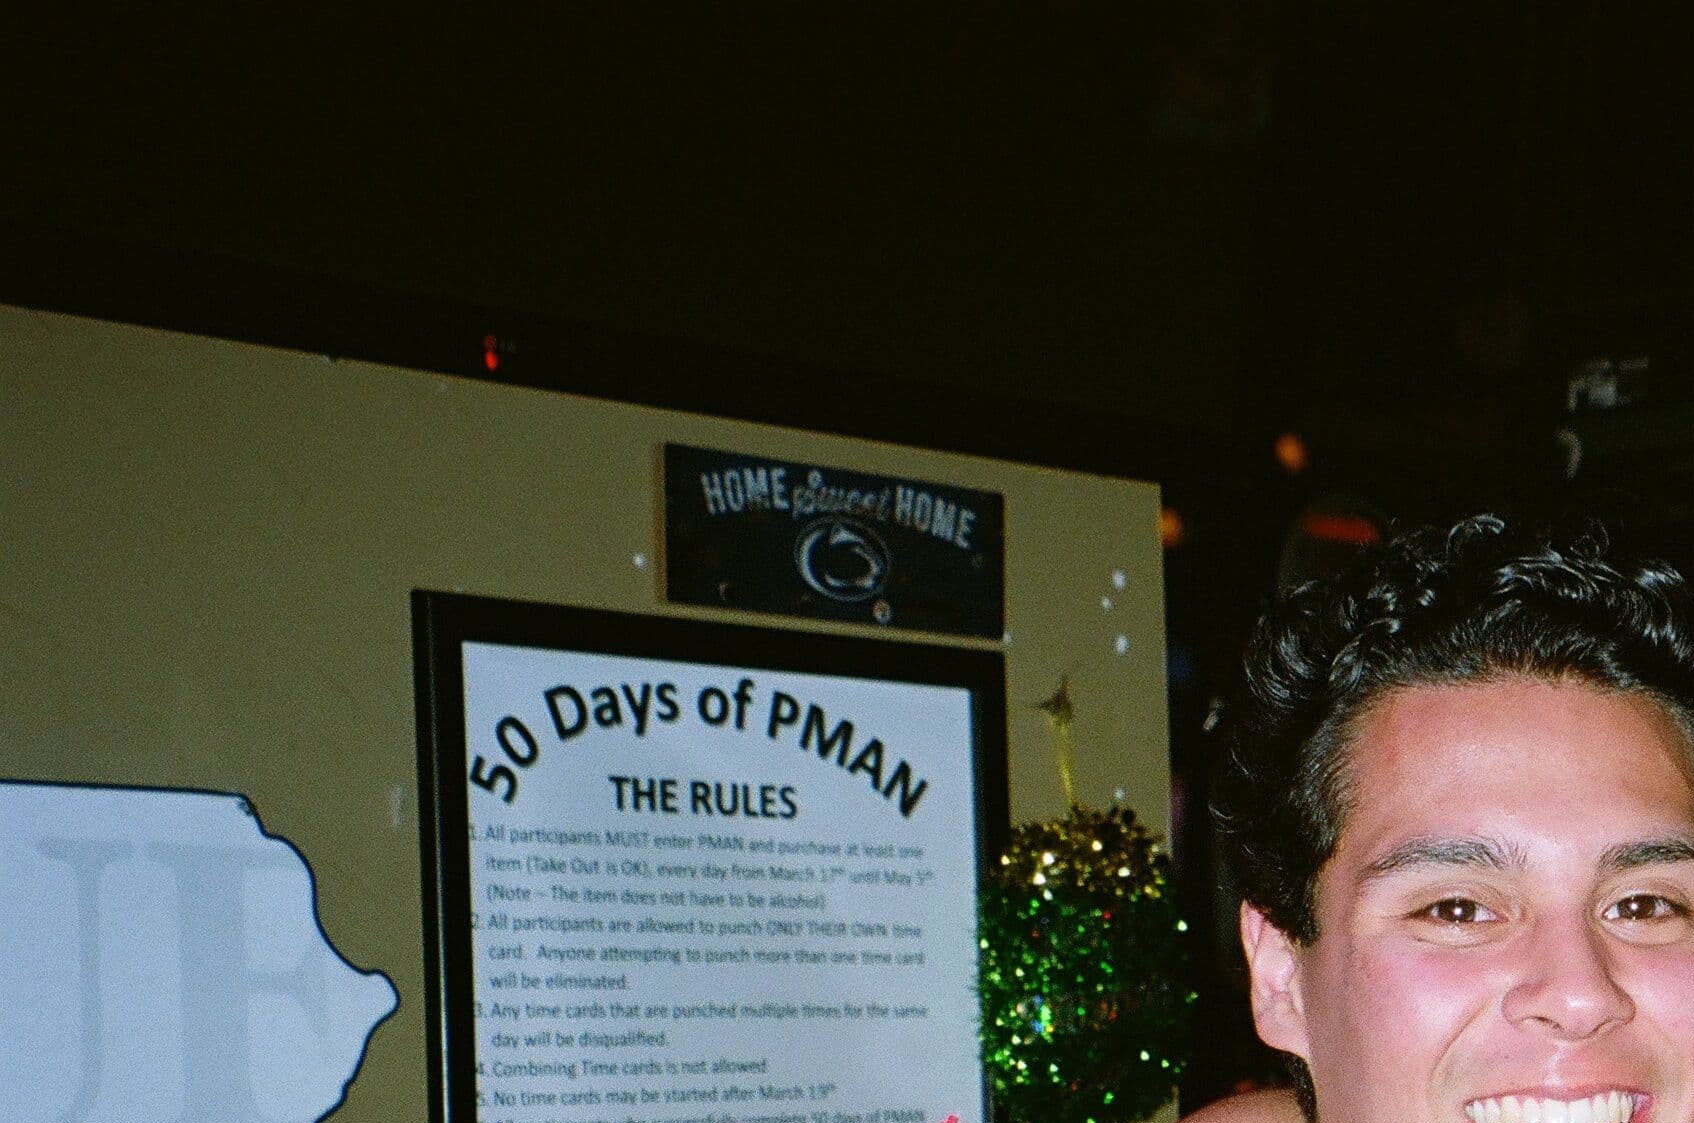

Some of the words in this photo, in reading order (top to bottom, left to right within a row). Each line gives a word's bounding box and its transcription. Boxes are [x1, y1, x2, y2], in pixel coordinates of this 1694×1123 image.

[701, 467, 789, 514] HOME
[895, 484, 977, 549] HOME
[470, 714, 540, 804] 50
[543, 679, 681, 742] Days
[696, 677, 754, 731] of
[765, 690, 929, 818] PMAN
[609, 775, 681, 814] THE
[690, 780, 799, 820] RULES
[510, 829, 600, 847] participants
[606, 831, 648, 847] MUST
[571, 858, 600, 873] Out
[513, 917, 603, 933] participants
